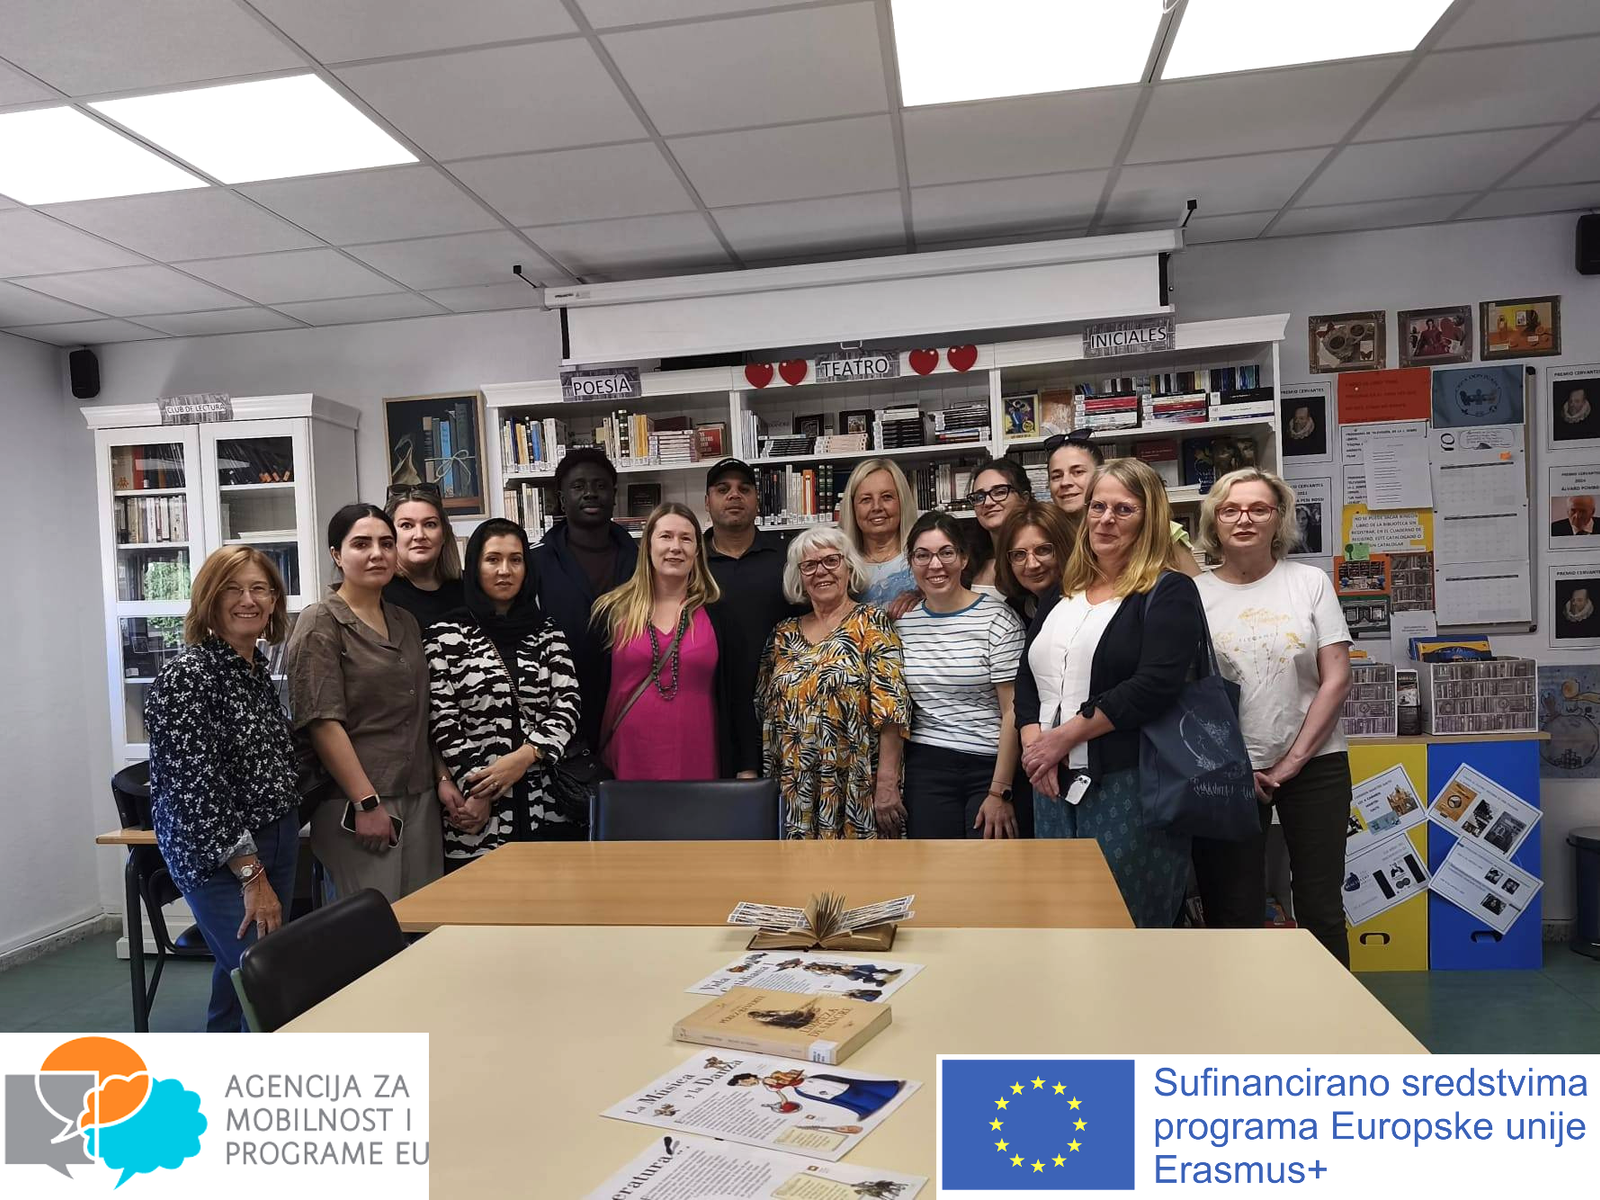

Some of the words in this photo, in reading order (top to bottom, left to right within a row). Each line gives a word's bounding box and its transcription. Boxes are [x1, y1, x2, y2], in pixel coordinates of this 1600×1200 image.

[1092, 327, 1166, 348] INICIALES
[822, 358, 888, 377] TEATRO
[574, 374, 630, 395] POESÍA
[167, 406, 184, 414] CLUB
[195, 404, 225, 412] LECTURA
[636, 1074, 696, 1105] Música
[612, 1156, 673, 1200] eratura
